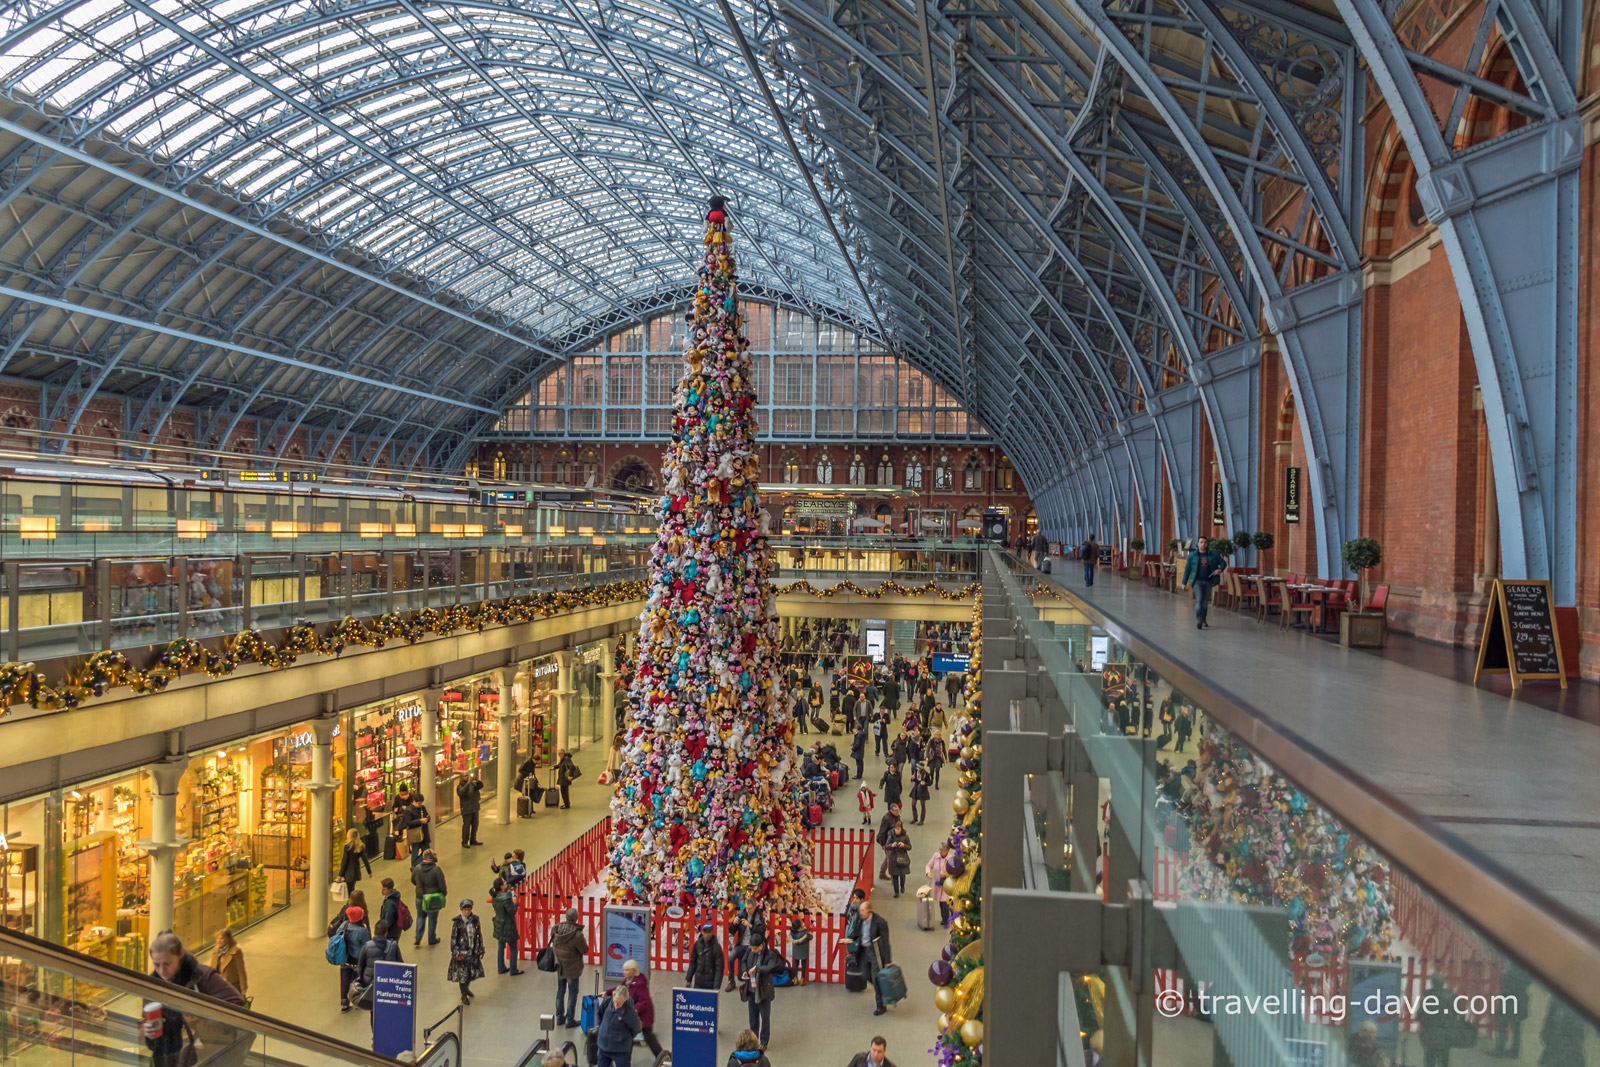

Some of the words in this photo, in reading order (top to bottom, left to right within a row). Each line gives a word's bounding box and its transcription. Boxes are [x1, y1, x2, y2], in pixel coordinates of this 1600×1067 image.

[303, 472, 308, 480] 5
[796, 500, 845, 508] SEARCYS
[1506, 585, 1542, 594] SEARCYS
[535, 662, 559, 678] RITUALS
[398, 705, 423, 721] RITU
